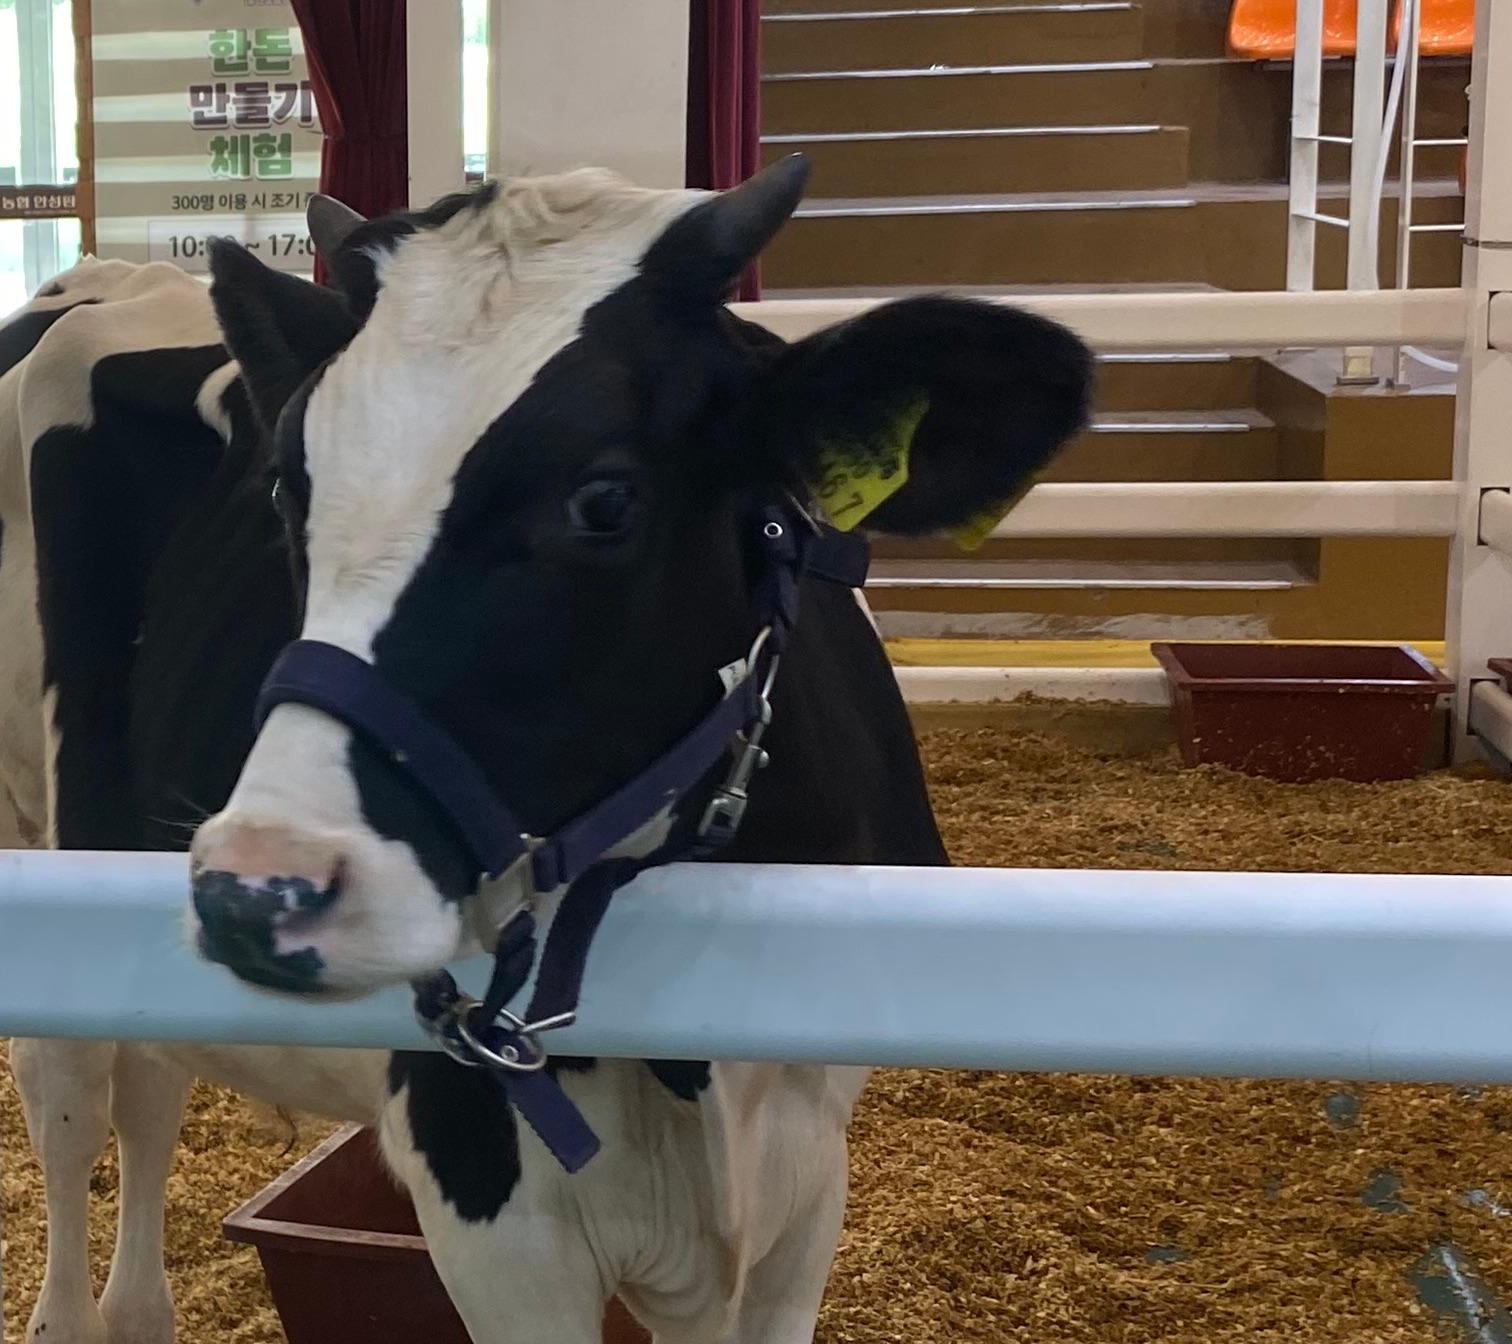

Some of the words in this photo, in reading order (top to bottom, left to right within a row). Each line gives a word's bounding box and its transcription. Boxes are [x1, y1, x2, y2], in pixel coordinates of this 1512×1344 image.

[208, 28, 293, 75] 한돈
[188, 81, 314, 127] 만들기
[209, 132, 293, 178] 체험
[171, 194, 215, 211] 300명
[218, 193, 248, 210] 이용
[252, 192, 267, 209] 시
[271, 192, 300, 208] 조기
